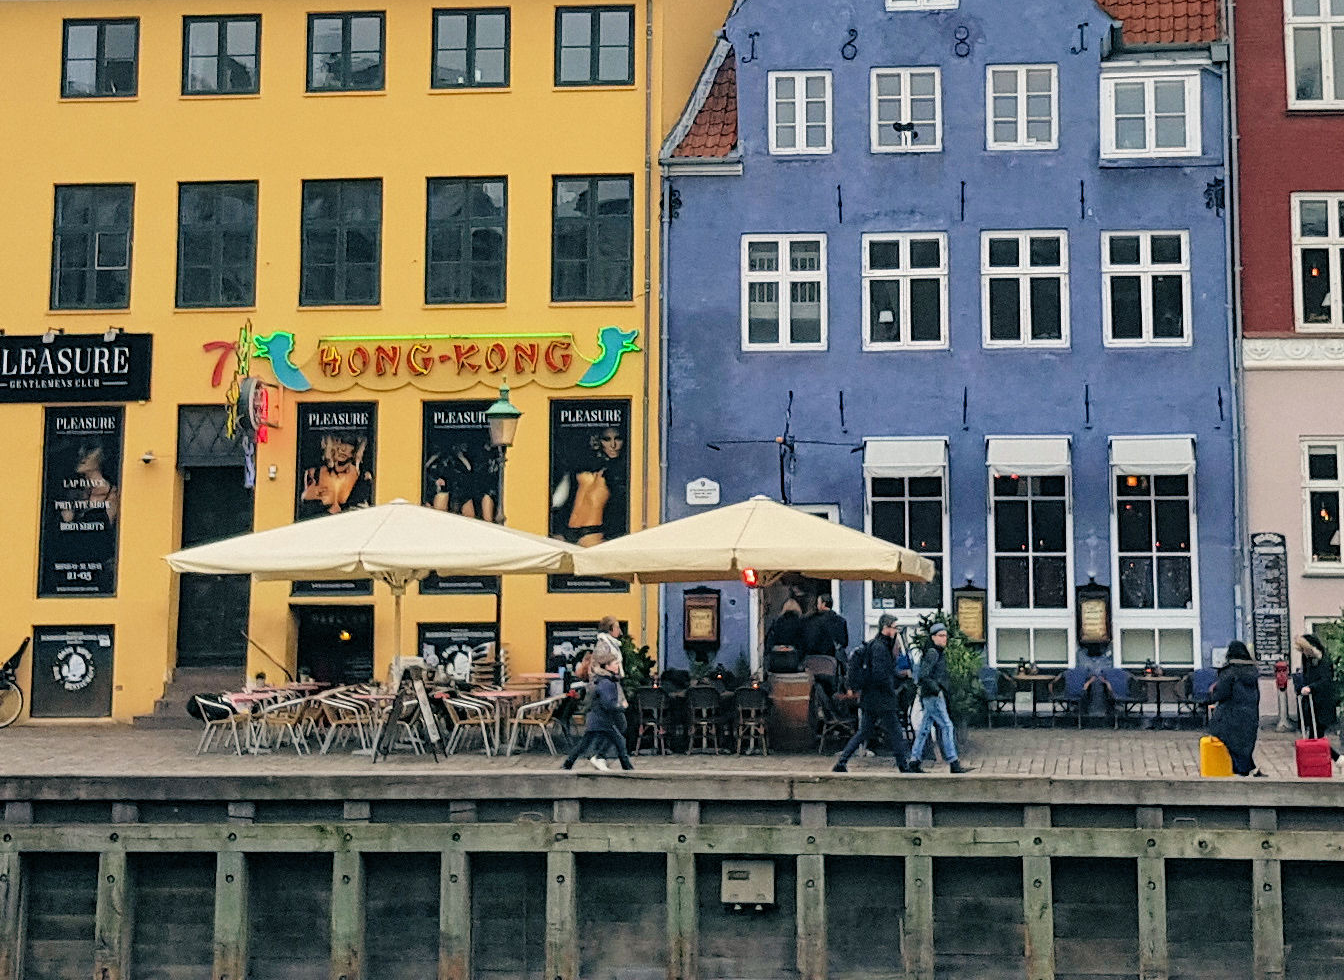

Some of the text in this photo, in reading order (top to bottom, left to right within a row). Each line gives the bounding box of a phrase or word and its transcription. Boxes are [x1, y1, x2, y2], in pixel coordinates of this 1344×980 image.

[318, 340, 574, 377] HONG-KONG
[9, 378, 100, 389] GENTLEMENS CLUB
[56, 416, 116, 430] PLEASURE
[308, 412, 369, 426] PLEASURE
[434, 411, 487, 424] PLEASUR
[560, 409, 621, 423] PLEASURE
